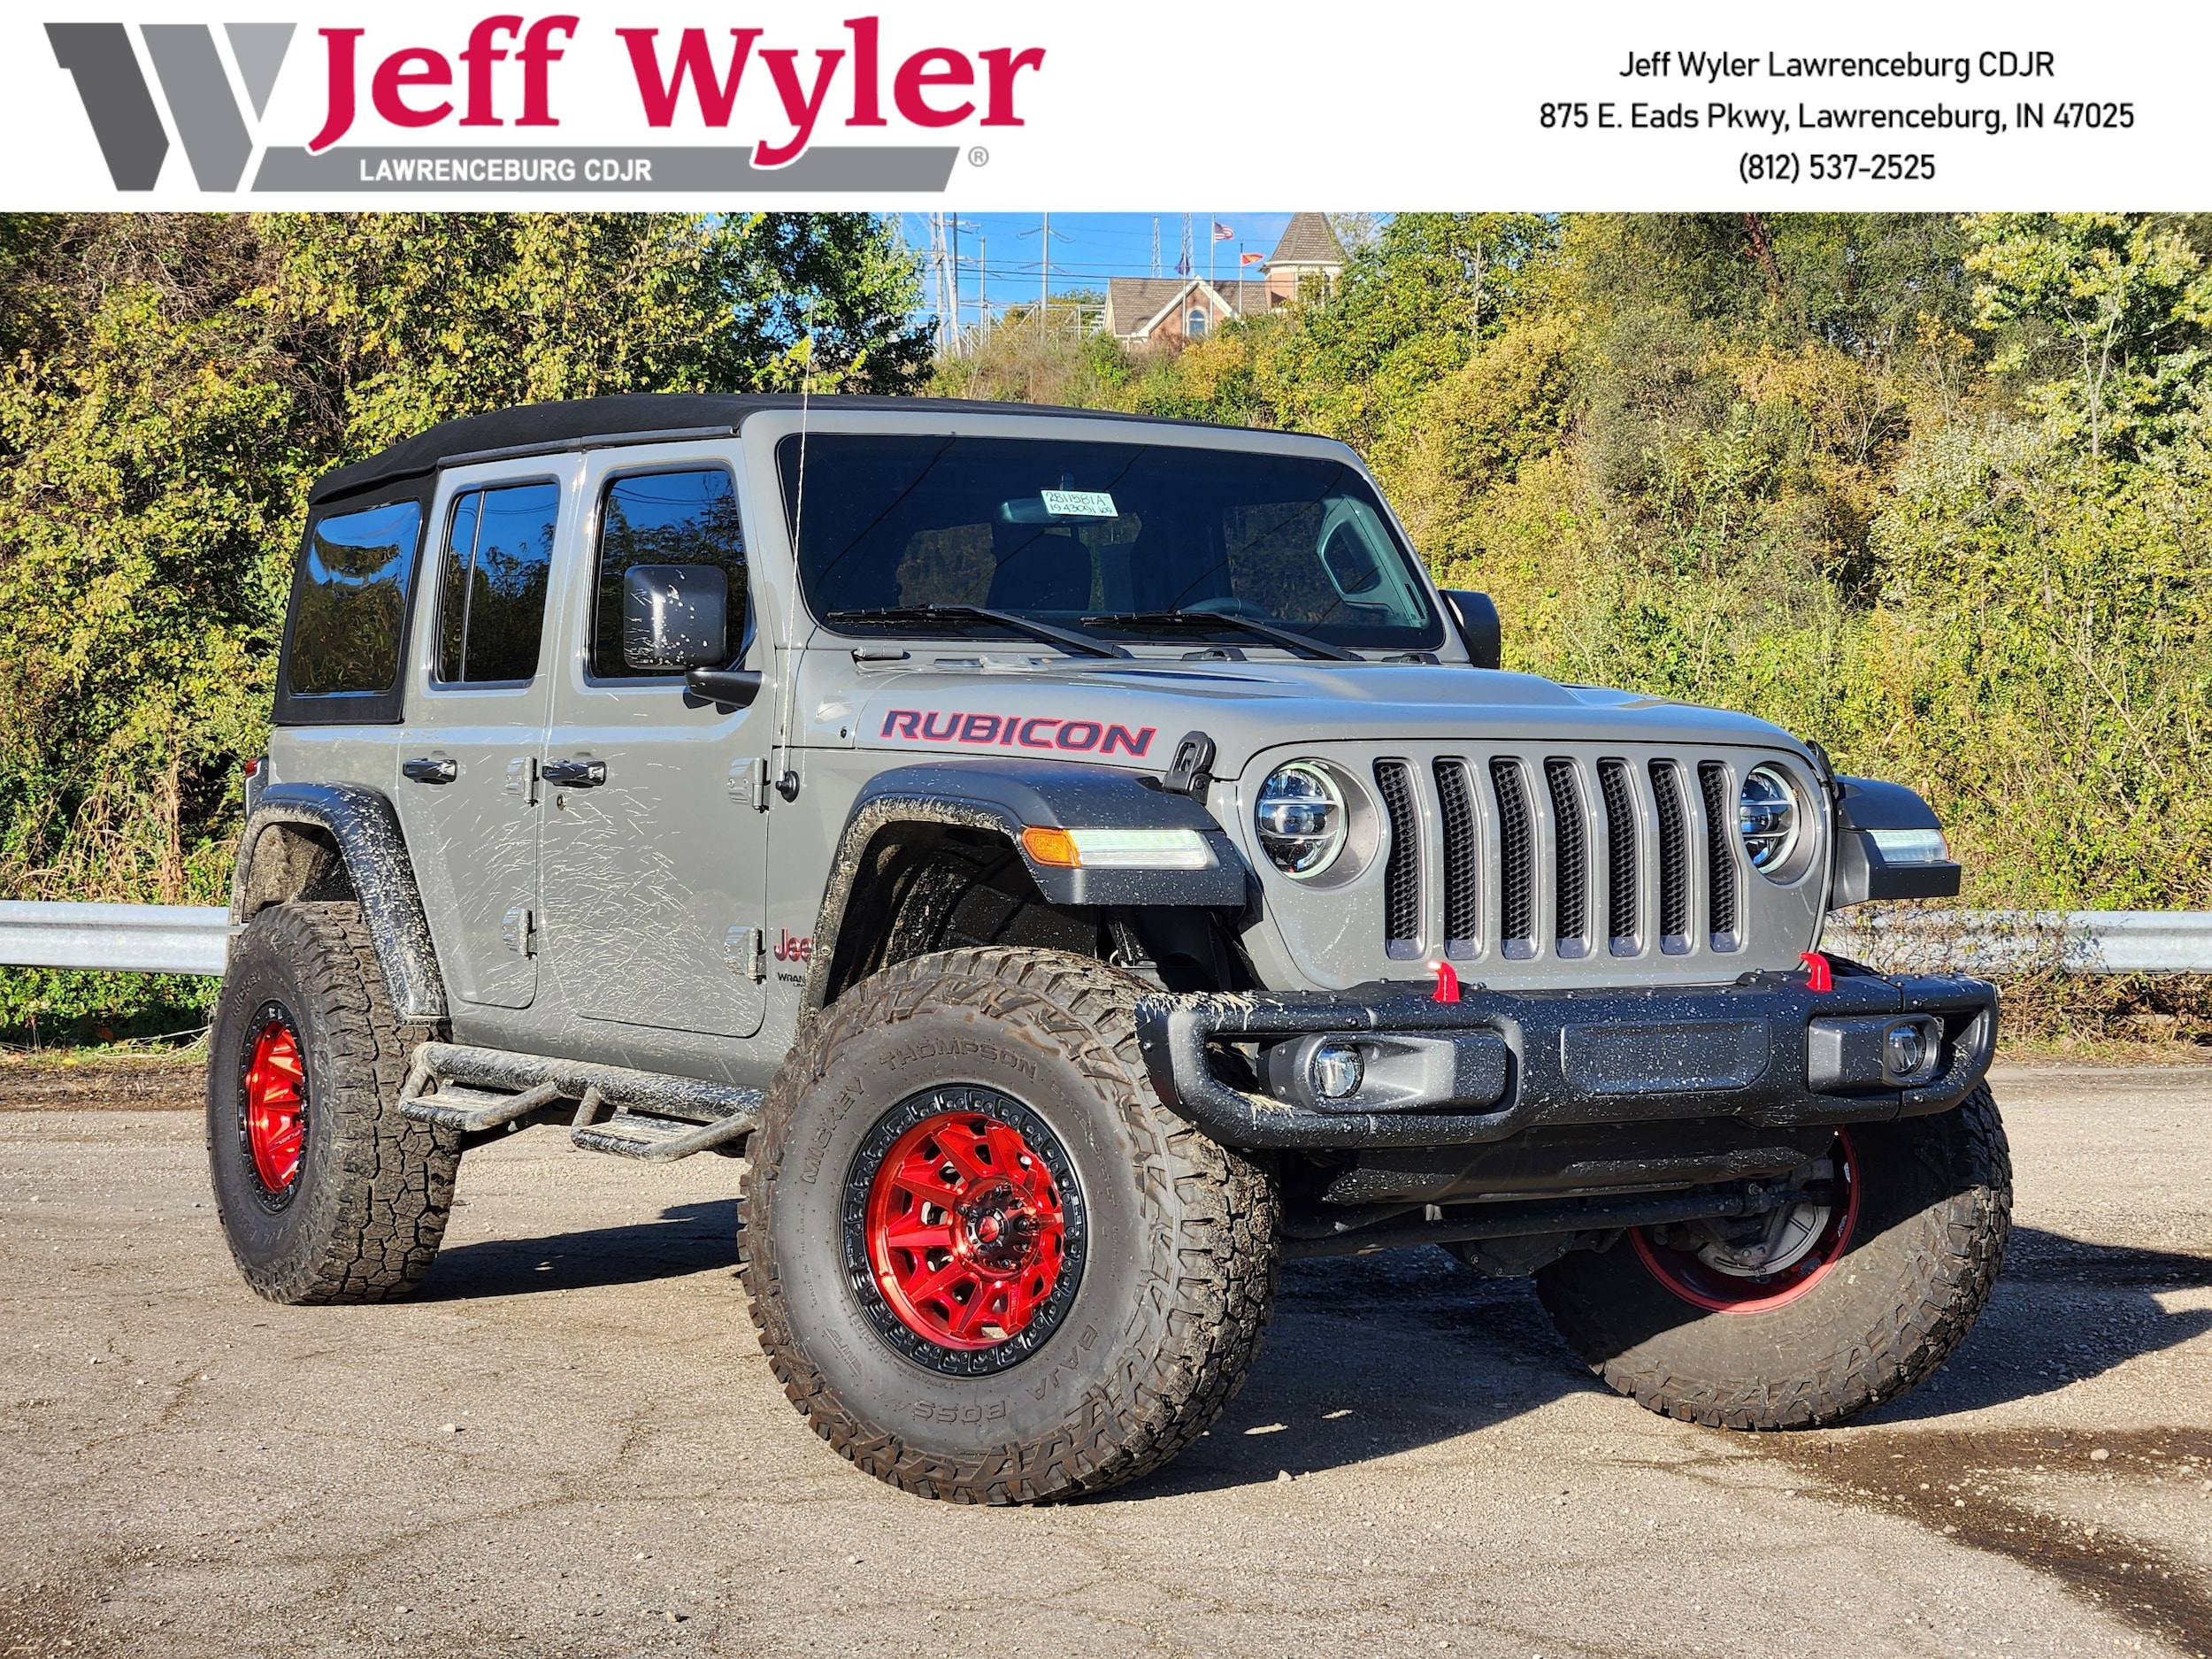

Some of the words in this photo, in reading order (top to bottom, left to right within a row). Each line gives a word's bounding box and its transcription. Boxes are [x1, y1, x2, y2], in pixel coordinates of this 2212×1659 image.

[880, 710, 1156, 757] RUBICON
[801, 1075, 866, 1185] MICKEY
[880, 1035, 1038, 1079] THOMPSON
[1027, 1323, 1100, 1402] BAJA
[911, 1398, 1007, 1424] BOSS
